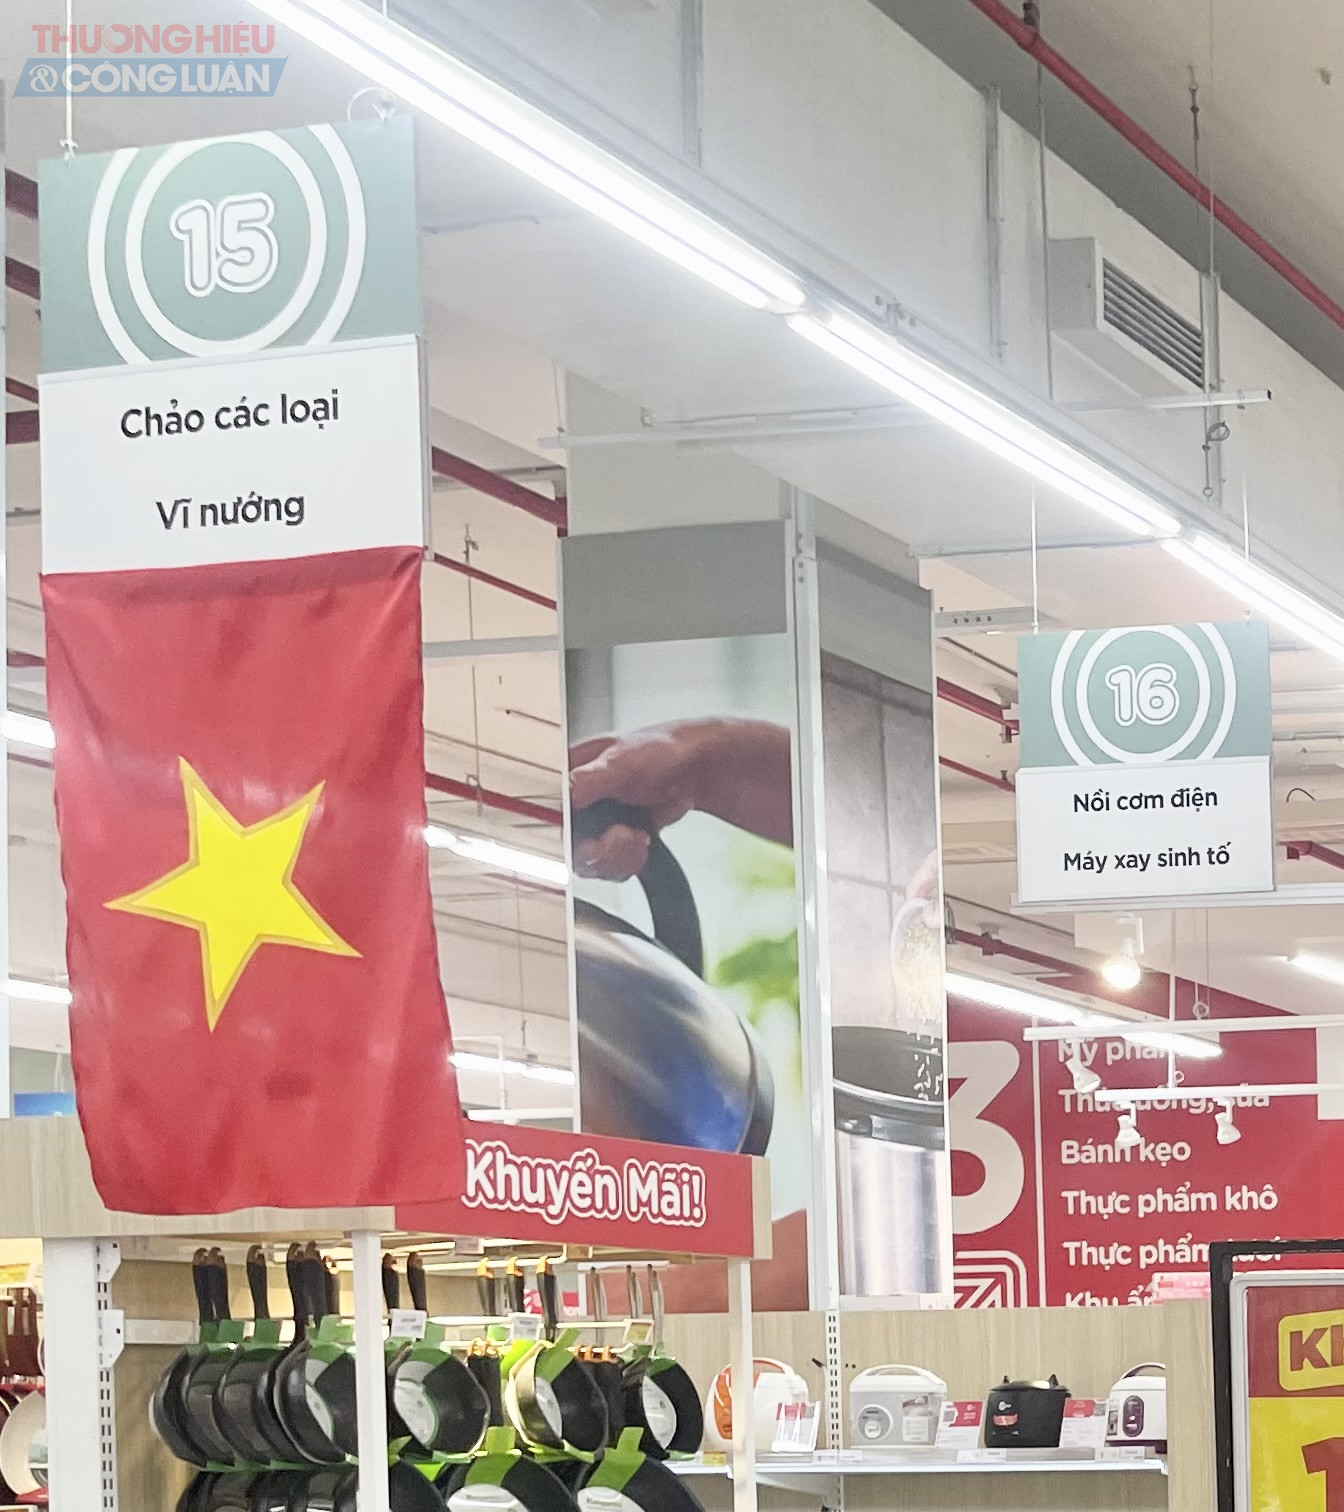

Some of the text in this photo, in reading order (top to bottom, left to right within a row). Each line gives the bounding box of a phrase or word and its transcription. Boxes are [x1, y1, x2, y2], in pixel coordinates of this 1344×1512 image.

[170, 192, 278, 297] 15
[120, 388, 341, 440] Chảo các loại
[155, 491, 306, 531] Vĩ nướng
[1105, 664, 1181, 728] 16
[1072, 786, 1219, 813] Nồi cơm điện
[1062, 842, 1231, 876] Máy xay sinh tố
[1061, 1138, 1192, 1167] Bánh kẹo
[465, 1142, 708, 1227] Khuyến Mãi!
[1061, 1181, 1279, 1220] Thực phẩm khô
[1063, 1239, 1132, 1272] Thực
